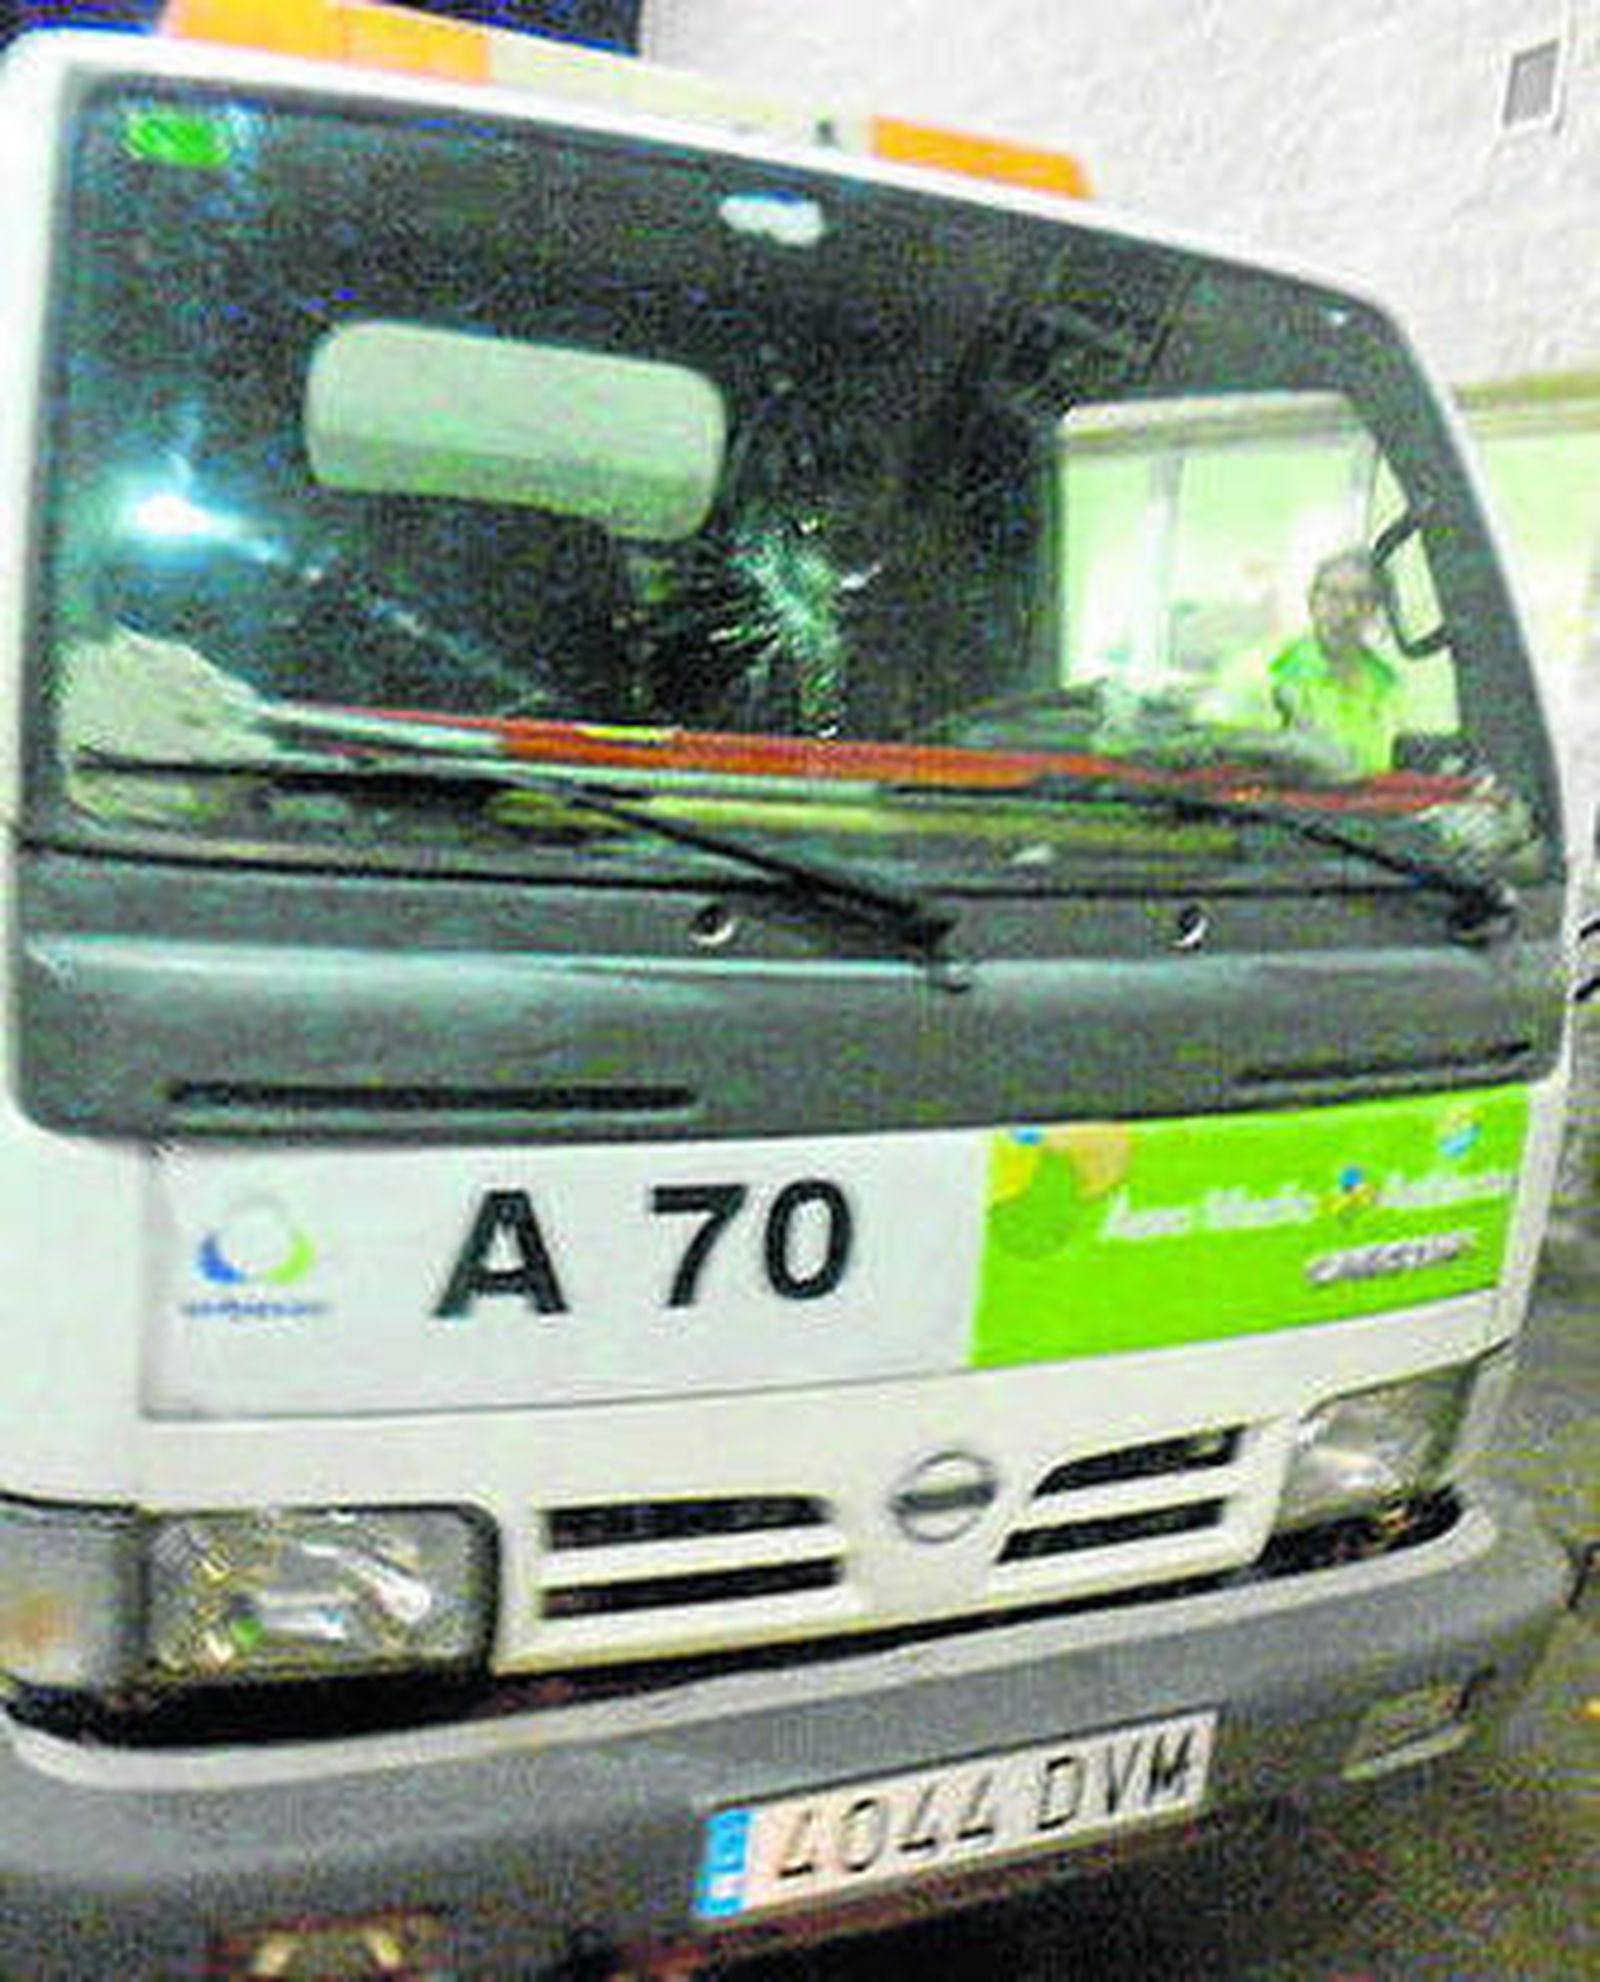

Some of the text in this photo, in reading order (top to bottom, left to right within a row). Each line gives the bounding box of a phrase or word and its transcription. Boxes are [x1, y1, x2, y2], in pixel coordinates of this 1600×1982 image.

[432, 1179, 855, 1319] A 70
[777, 1730, 1195, 1879] 4044 DVM
